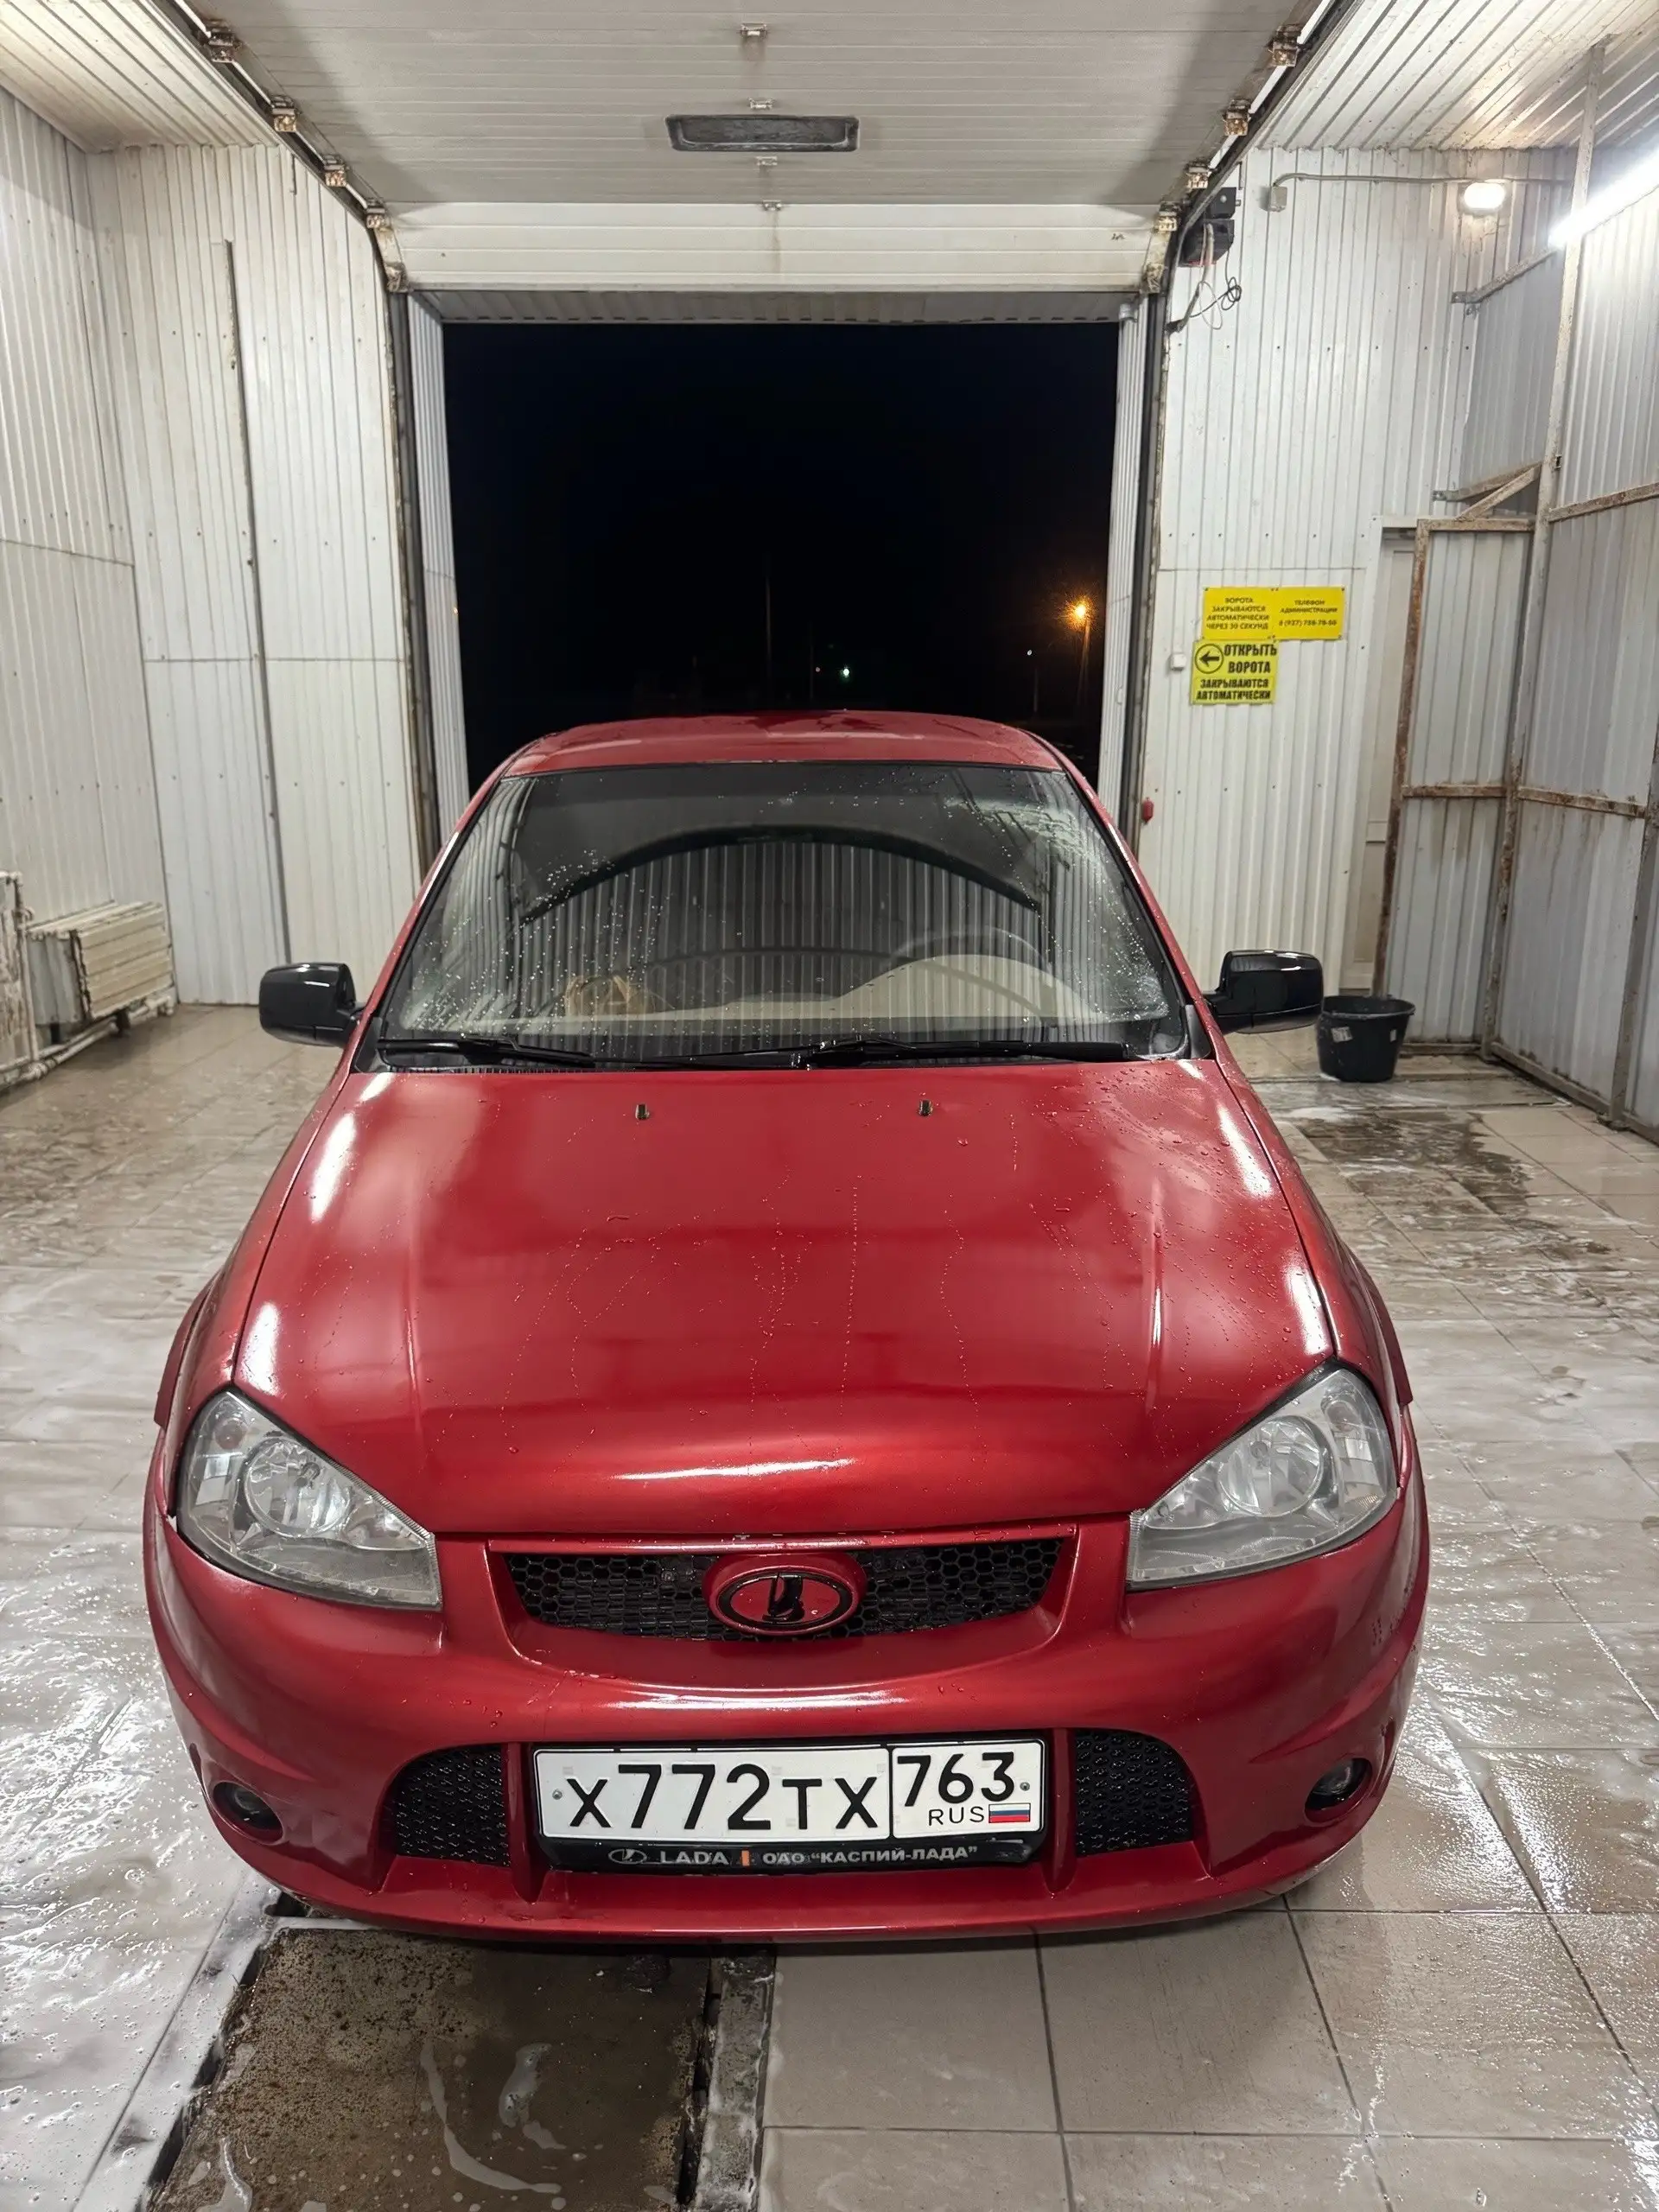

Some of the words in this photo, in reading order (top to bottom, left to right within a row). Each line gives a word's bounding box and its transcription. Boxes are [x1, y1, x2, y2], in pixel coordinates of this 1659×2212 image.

[1224, 644, 1277, 656] ОТКРЫТЬ
[1228, 661, 1271, 673] ВОРОТА
[1200, 678, 1268, 688] ЗАКРЫВАЮТСЯ
[1196, 690, 1271, 700] АВТОМАТИЧЕСКИ
[897, 1751, 1015, 1808] 763
[928, 1806, 985, 1826] RUS
[659, 1850, 729, 1865] LADA
[762, 1851, 805, 1866] ОАО
